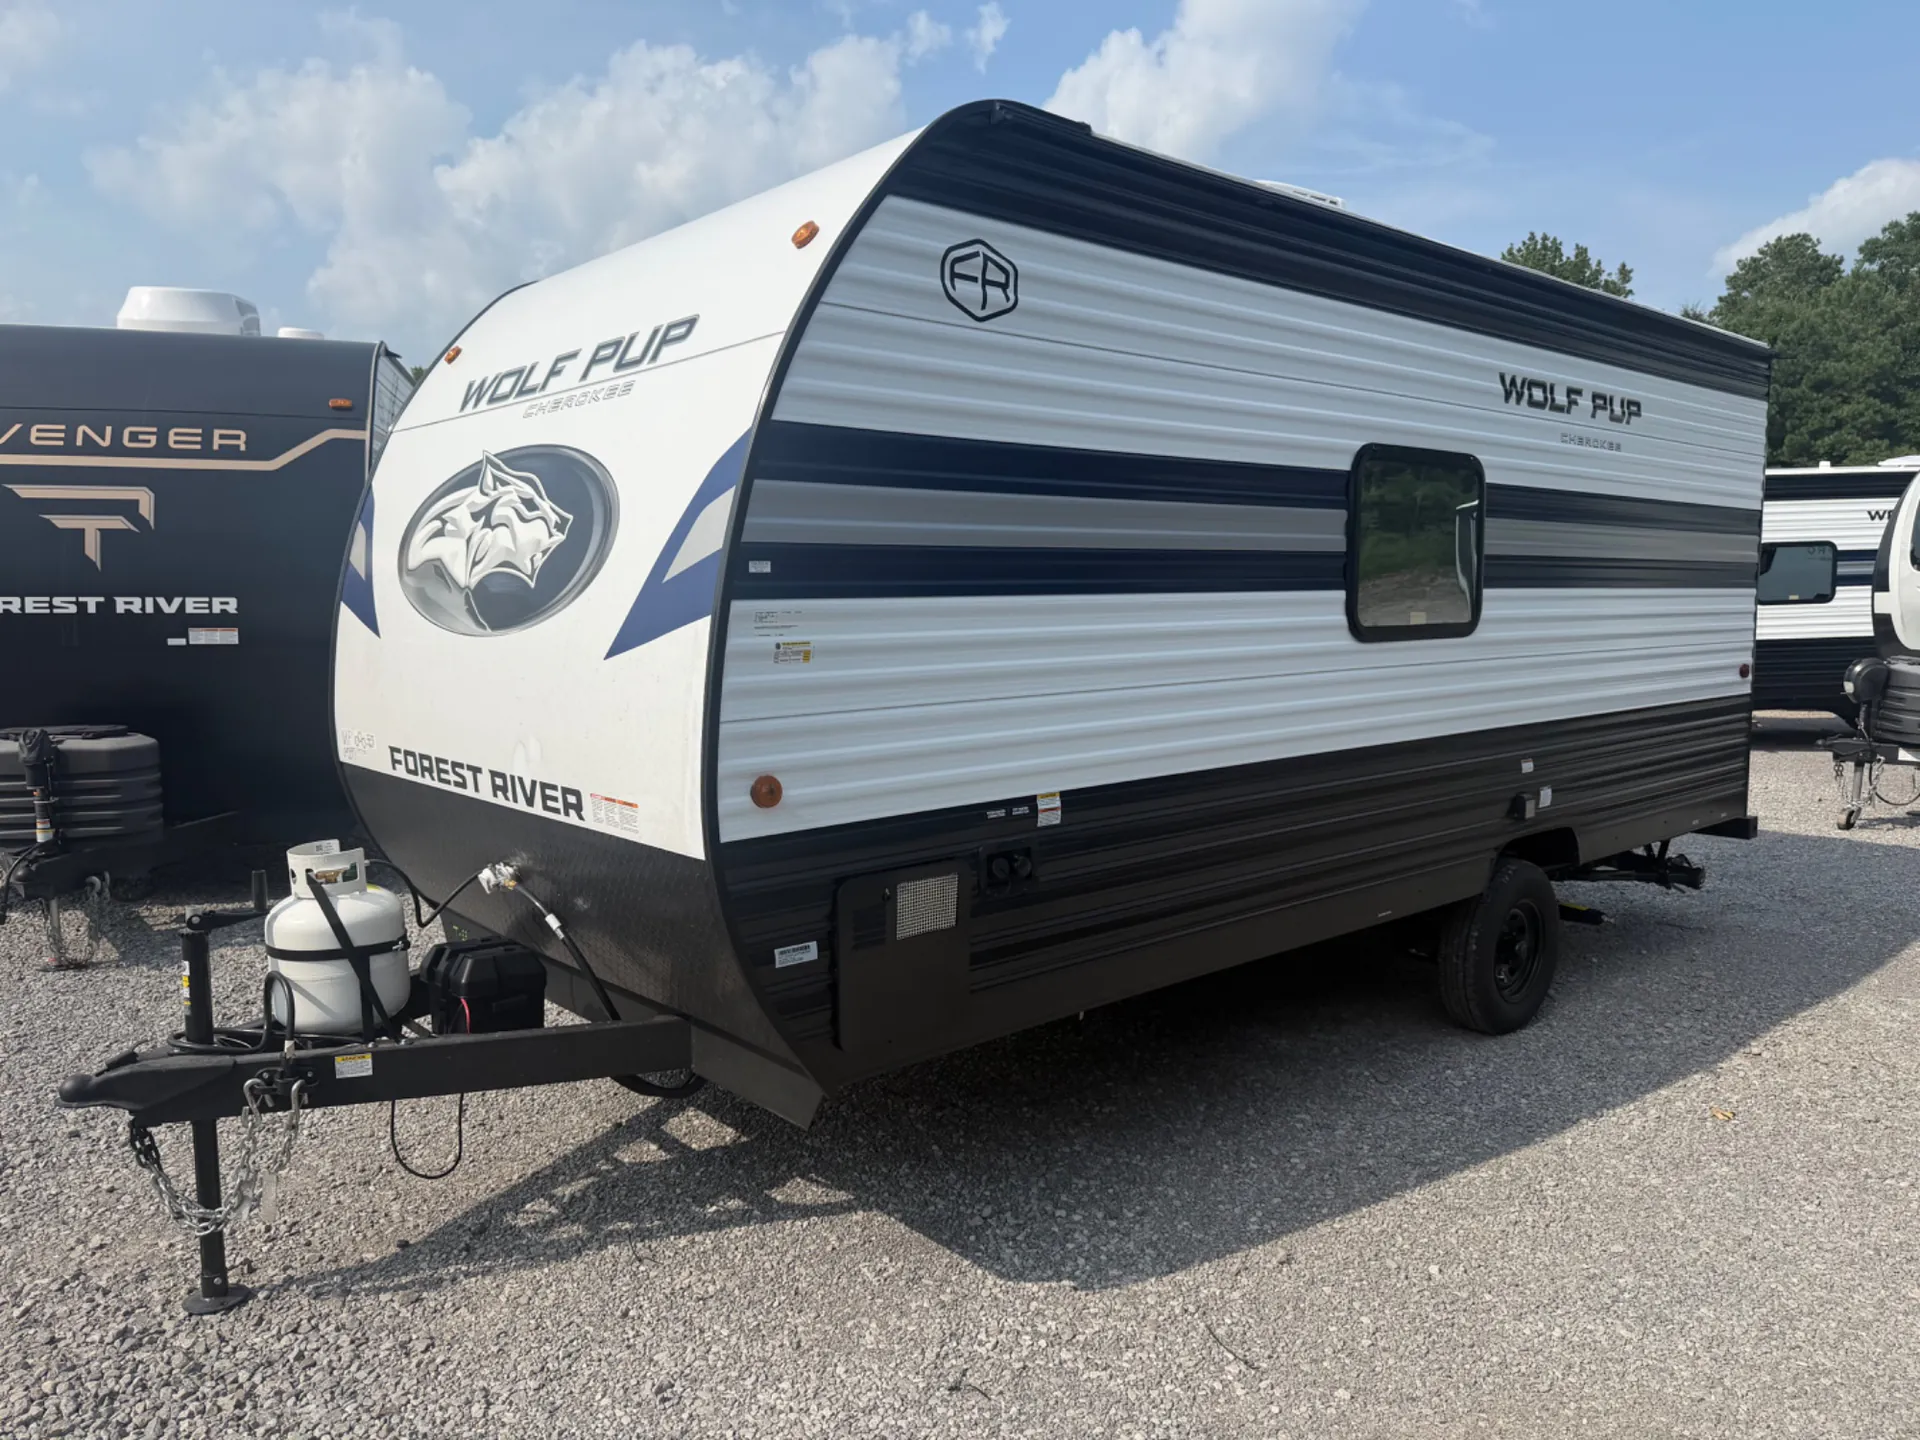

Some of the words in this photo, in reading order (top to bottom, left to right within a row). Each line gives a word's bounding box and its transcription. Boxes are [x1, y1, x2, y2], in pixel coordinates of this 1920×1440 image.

[459, 348, 583, 413] WOLF
[578, 313, 701, 383] PUP
[522, 379, 636, 419] CHEROKEE
[1498, 371, 1584, 415] WOLF
[1590, 390, 1643, 426] PUP
[1559, 431, 1622, 453] CHEROKEE
[113, 596, 239, 614] RIVER
[388, 745, 483, 794] FOREST
[488, 768, 586, 822] RIVER
